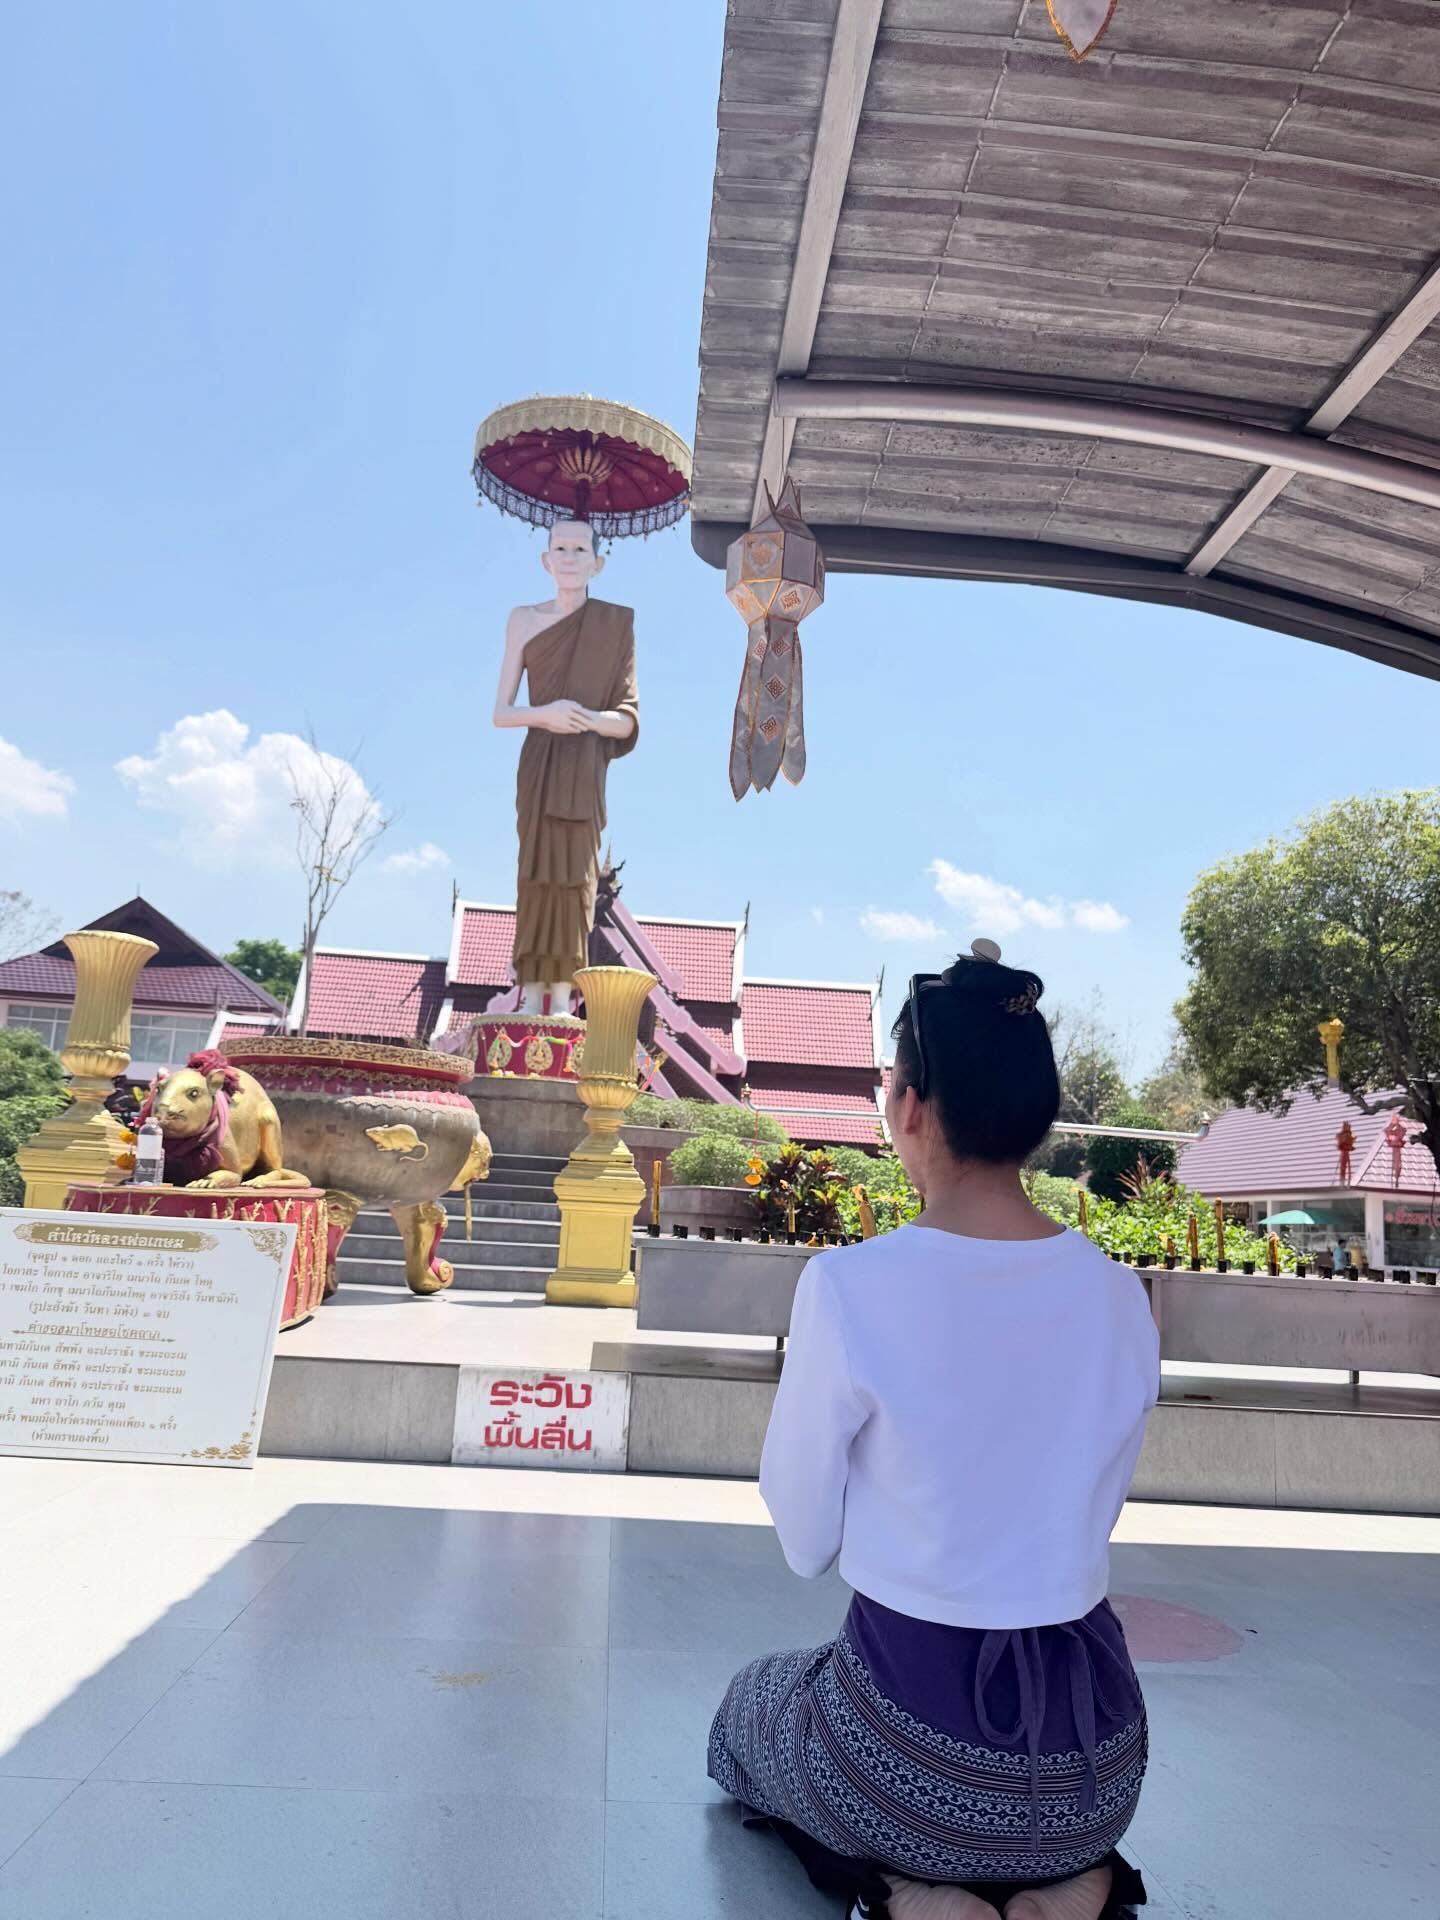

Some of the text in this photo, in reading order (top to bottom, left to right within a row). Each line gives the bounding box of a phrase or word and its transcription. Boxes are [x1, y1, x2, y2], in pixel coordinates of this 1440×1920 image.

[47, 1227, 185, 1249] คำไหว้หลวงพ่อเกษม
[489, 1373, 593, 1409] ระวัง
[483, 1411, 593, 1451] พื้นลื่น
